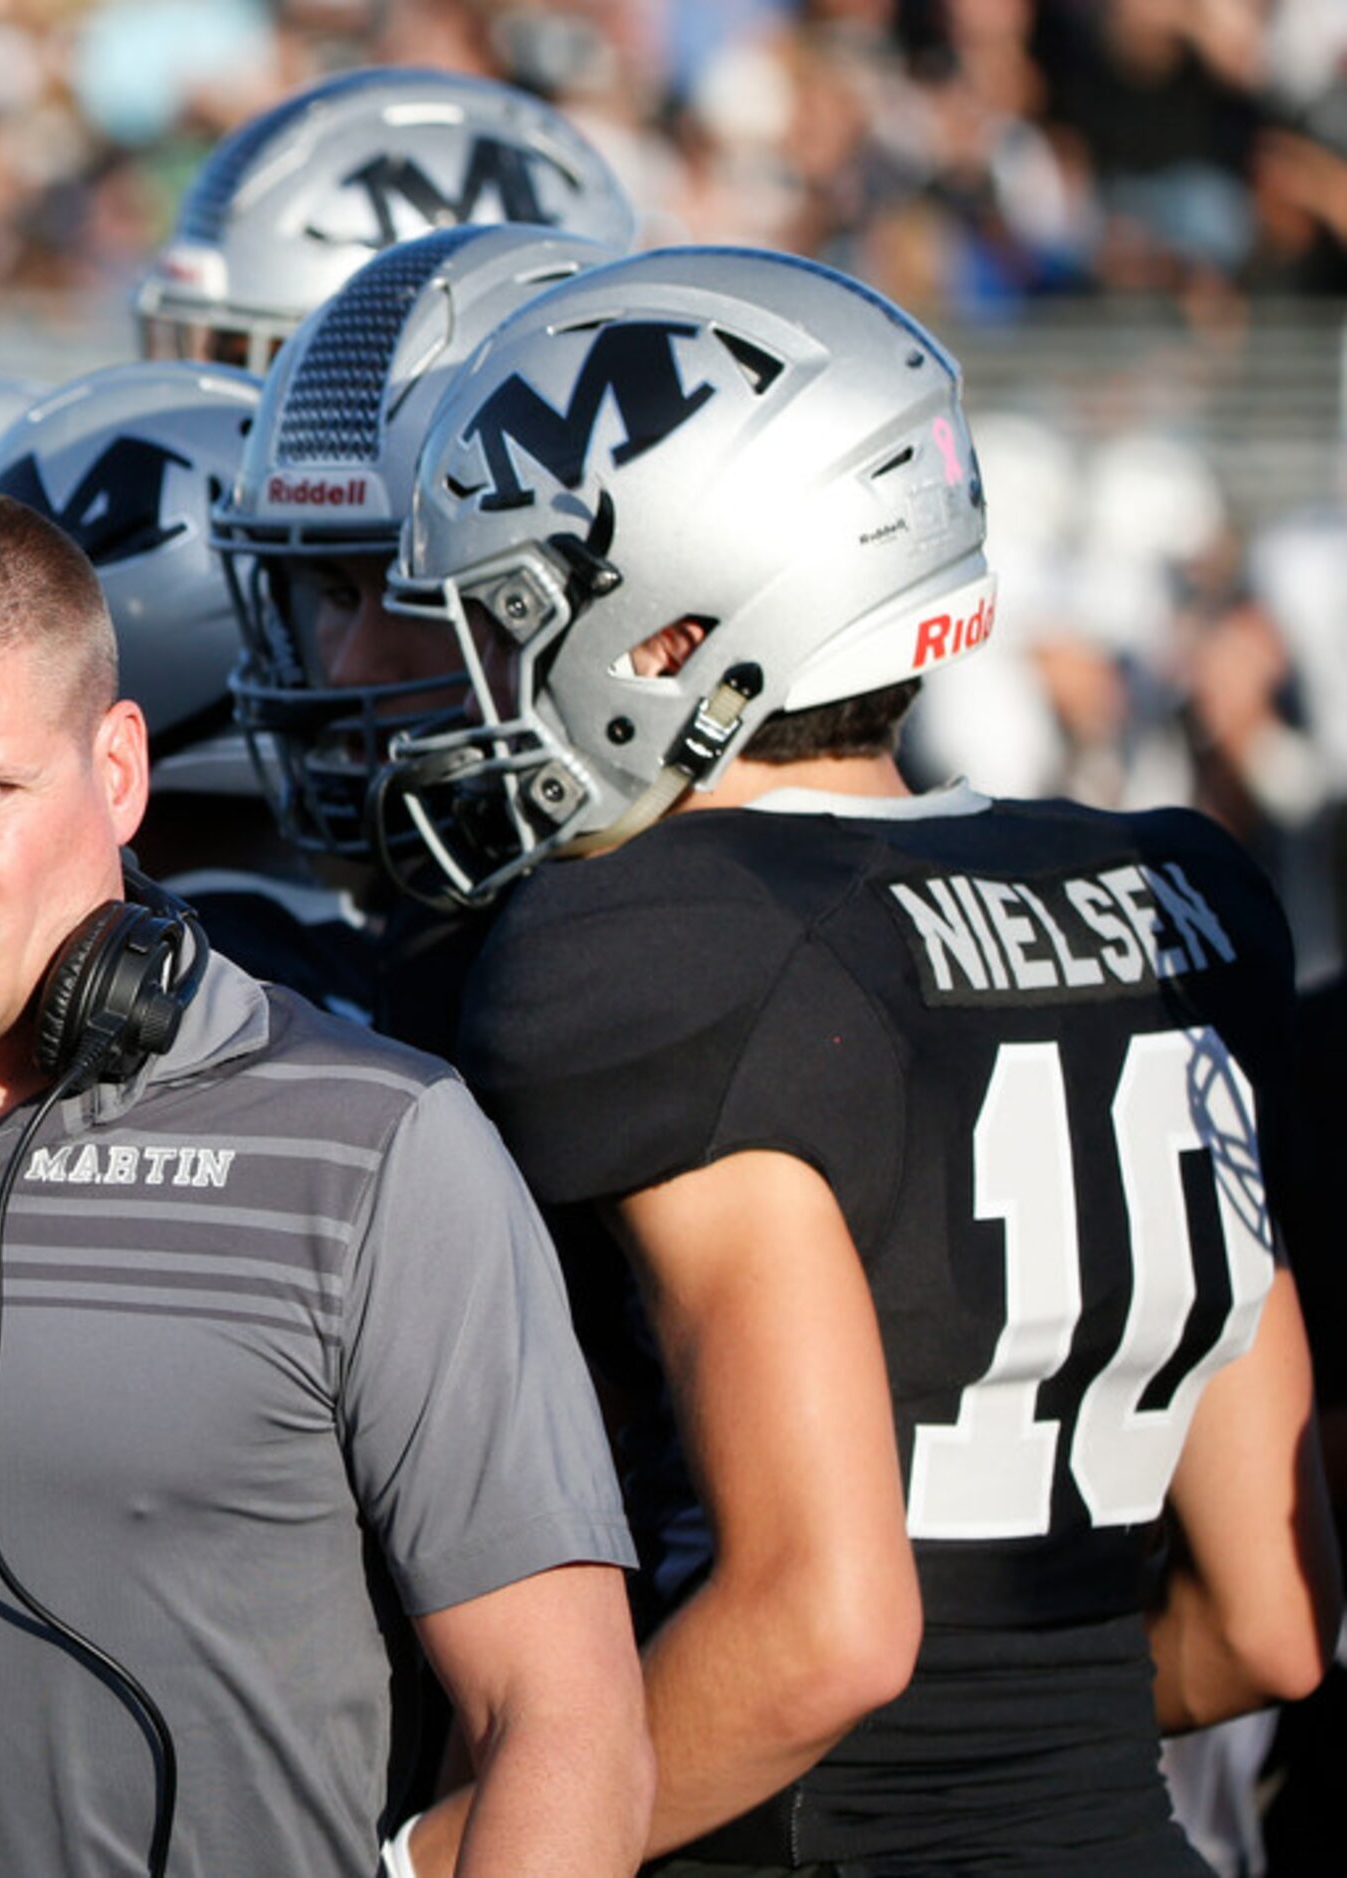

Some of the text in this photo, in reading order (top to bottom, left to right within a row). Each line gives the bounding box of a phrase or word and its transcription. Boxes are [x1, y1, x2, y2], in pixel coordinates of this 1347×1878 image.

[459, 320, 717, 512] M
[269, 478, 367, 506] Riddell
[888, 862, 1238, 990] NIELSEN
[23, 1143, 236, 1188] MARTIN
[905, 1025, 1275, 1540] 10
